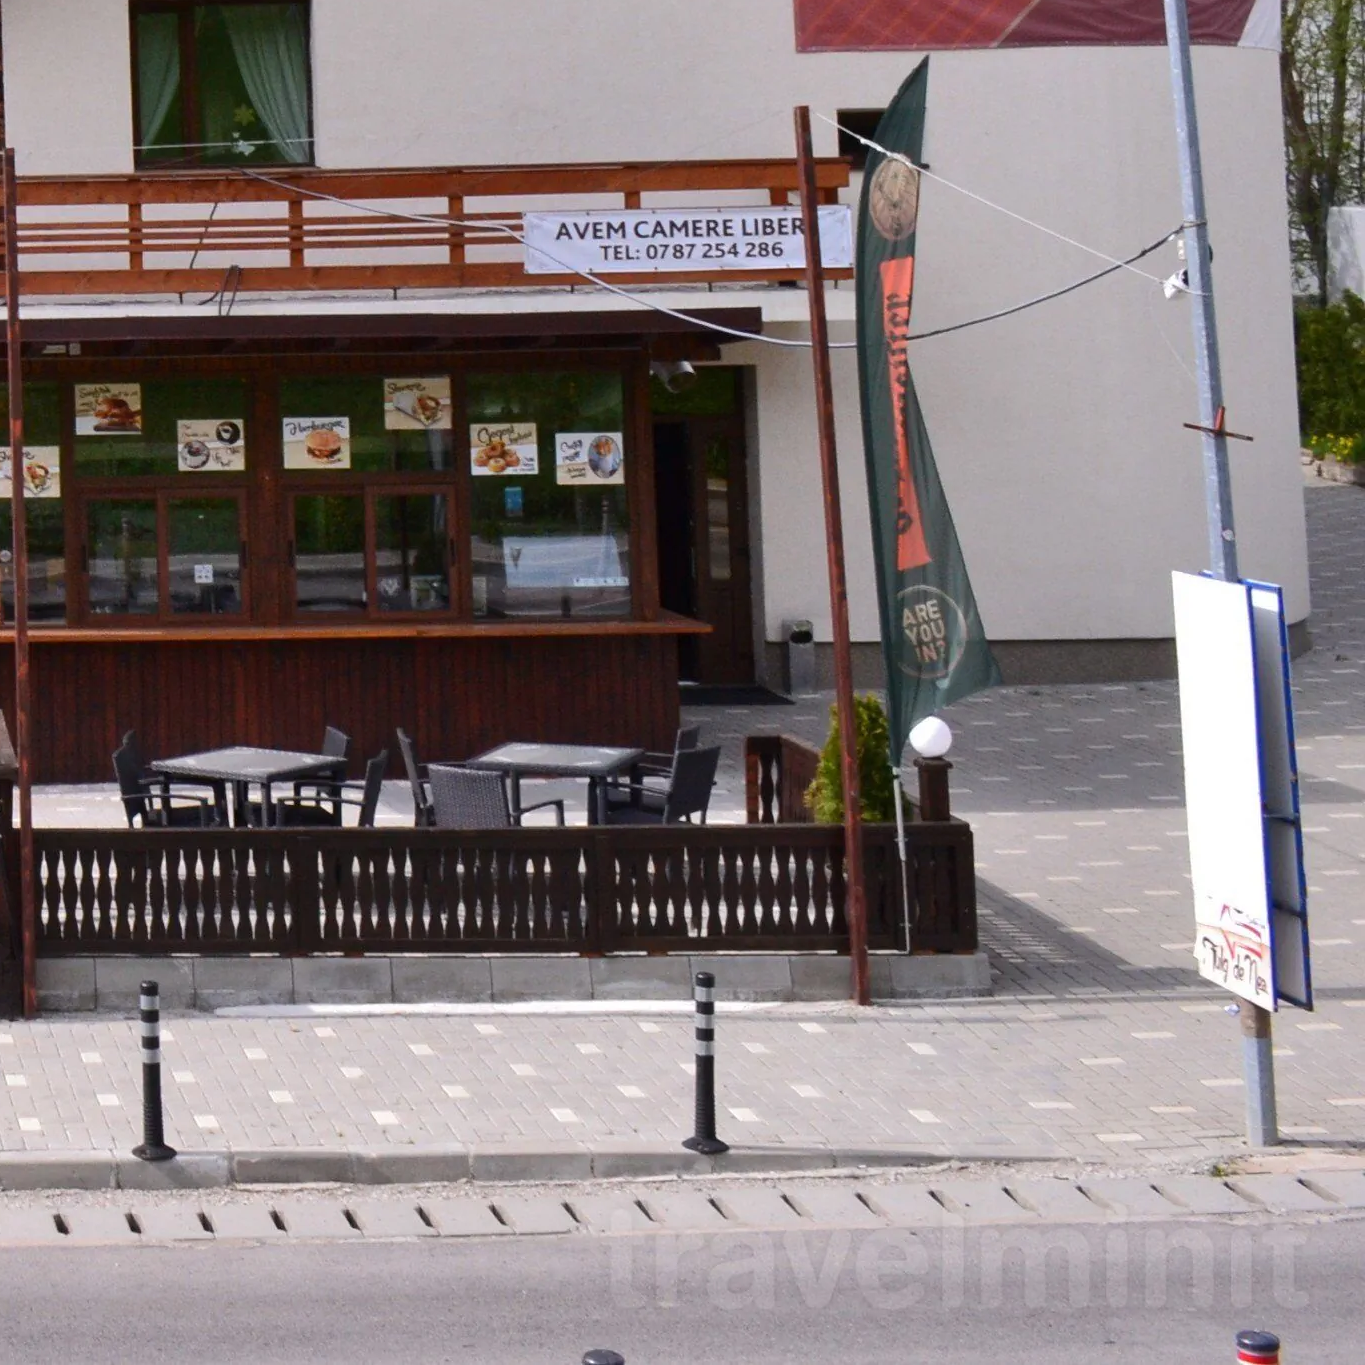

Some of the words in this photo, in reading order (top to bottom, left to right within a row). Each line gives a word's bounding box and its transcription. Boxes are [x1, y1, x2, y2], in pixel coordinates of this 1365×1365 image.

[555, 220, 627, 240] AVEM
[633, 218, 734, 239] CAMERE
[740, 217, 805, 237] LIBER
[600, 245, 641, 261] TEL:
[646, 244, 695, 260] 0787
[702, 243, 740, 259] 254
[745, 241, 784, 258] 286
[903, 599, 941, 625] ARE
[904, 619, 945, 646] YOU
